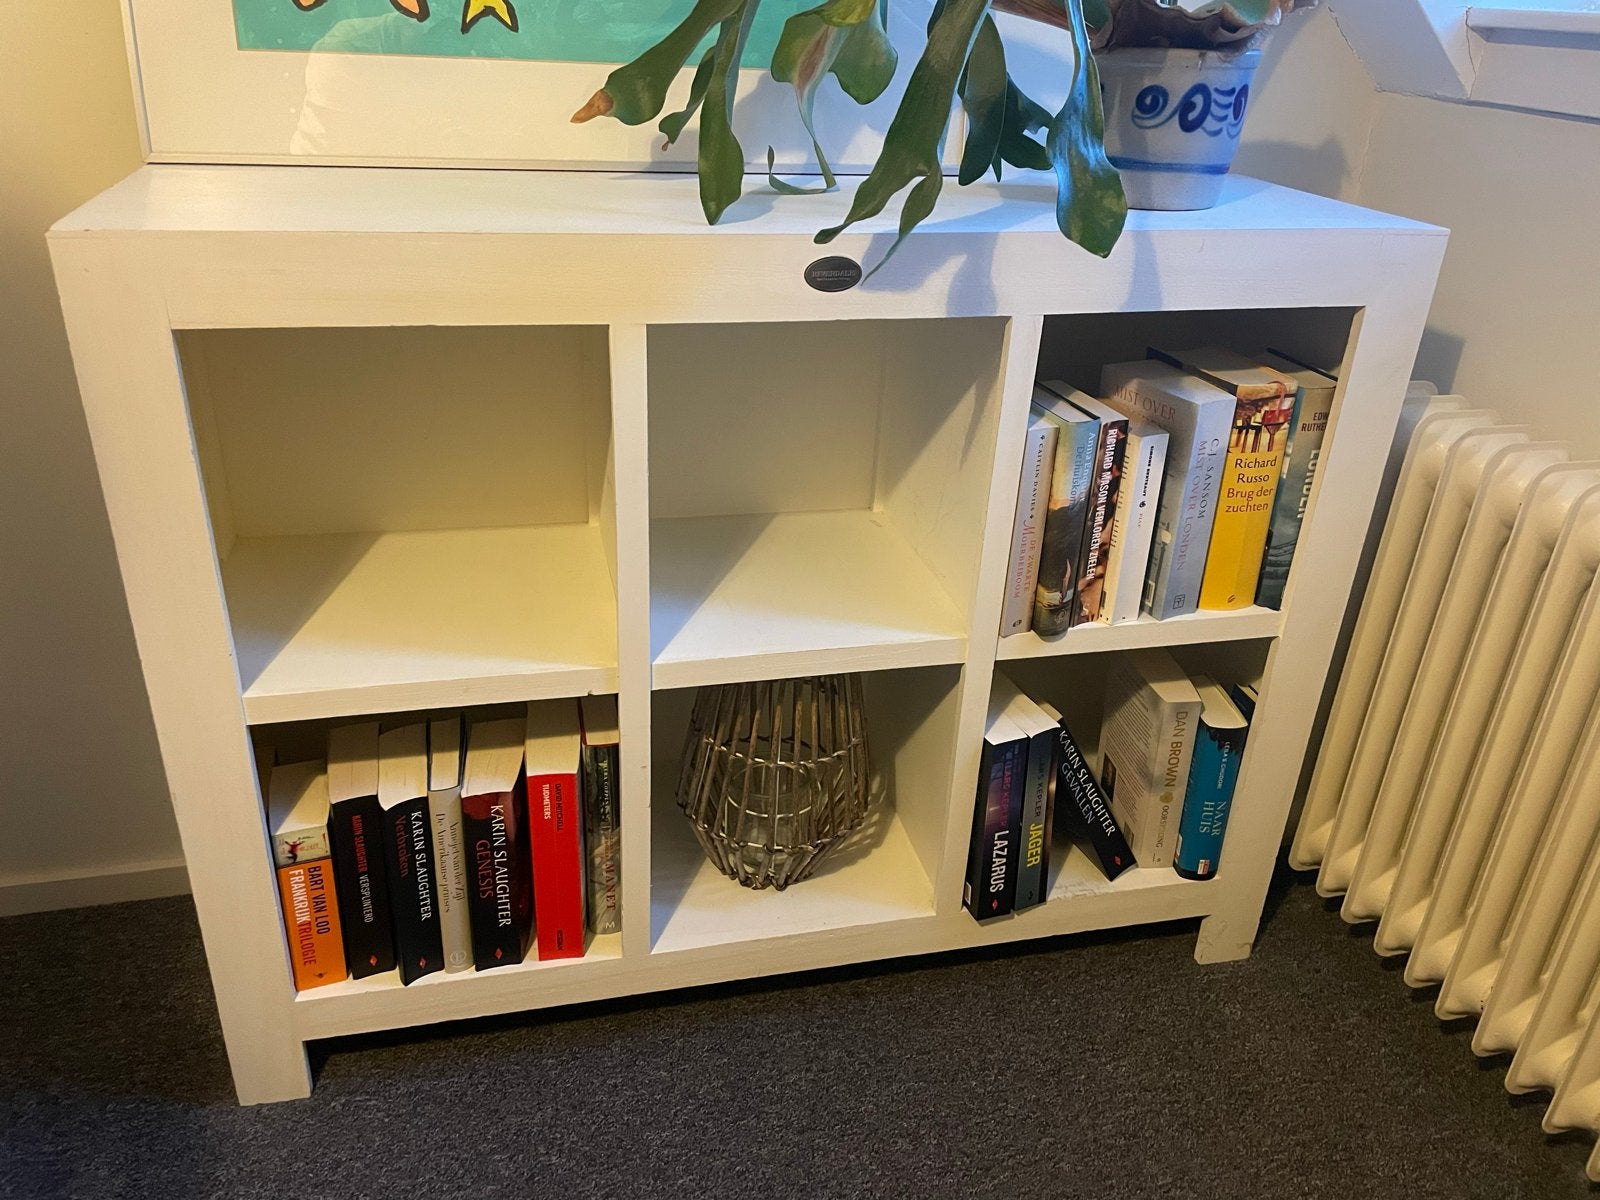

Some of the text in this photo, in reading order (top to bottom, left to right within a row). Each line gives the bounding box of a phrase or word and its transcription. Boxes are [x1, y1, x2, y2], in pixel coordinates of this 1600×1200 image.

[1142, 393, 1177, 420] OVER
[1086, 432, 1096, 460] Anna
[1234, 456, 1278, 469] Richard
[1030, 443, 1044, 512] CAITLIN DAVIES
[1086, 428, 1118, 580] RICHARD MASON VERLOREN ZIELEN
[1197, 465, 1214, 519] SANSOM
[1226, 486, 1274, 502] Brug der
[1236, 472, 1270, 484] Russo
[1176, 440, 1208, 571] MIST OVER LONDEN
[1225, 501, 1269, 513] zuchten
[1164, 711, 1189, 787] DAN BROWN
[542, 784, 551, 820] TIJDMETERS
[1034, 782, 1044, 818] KEPLER
[1058, 730, 1115, 837] KARIN SLAUGHTER
[1061, 762, 1096, 824] GEVALLEN
[1156, 805, 1170, 848] OORSONG
[1200, 801, 1215, 833] HUIS
[1211, 801, 1227, 836] NAAR
[352, 814, 374, 923] KARIN SLAUGHTER VERSPLINTERD
[394, 815, 412, 878] Verbroken
[411, 810, 432, 921] KARIN SLAUGHTER
[476, 839, 494, 899] GENESIS
[491, 805, 512, 928] KARIN SLAUGHTER
[990, 830, 1010, 893] LAZARUS
[1026, 824, 1044, 867] JAGER
[308, 866, 330, 935] BART VAN LOO
[604, 863, 616, 910] MANET
